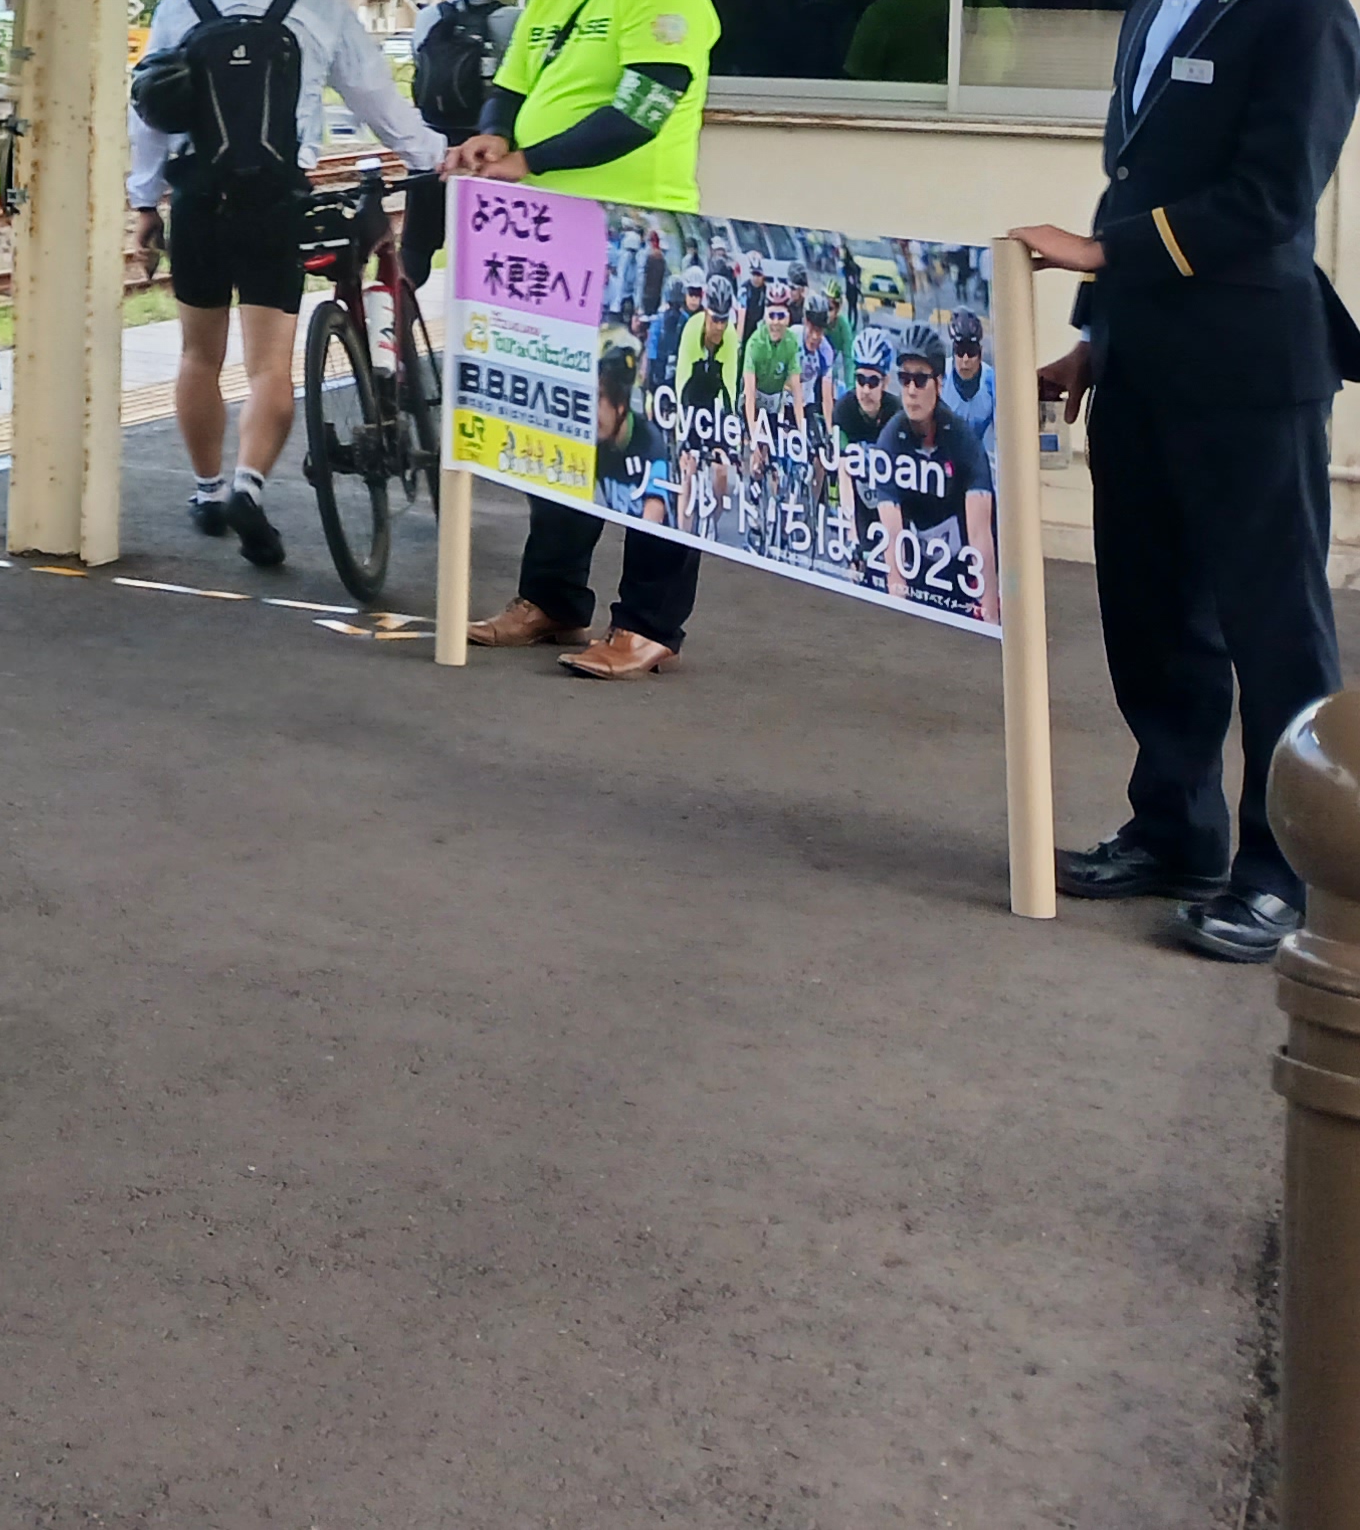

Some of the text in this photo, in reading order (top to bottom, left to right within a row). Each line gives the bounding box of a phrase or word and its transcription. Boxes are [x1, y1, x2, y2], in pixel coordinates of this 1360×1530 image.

[471, 193, 553, 243] ようこそ
[653, 384, 947, 499] Cycle Aid Japan
[866, 520, 986, 599] 2023
